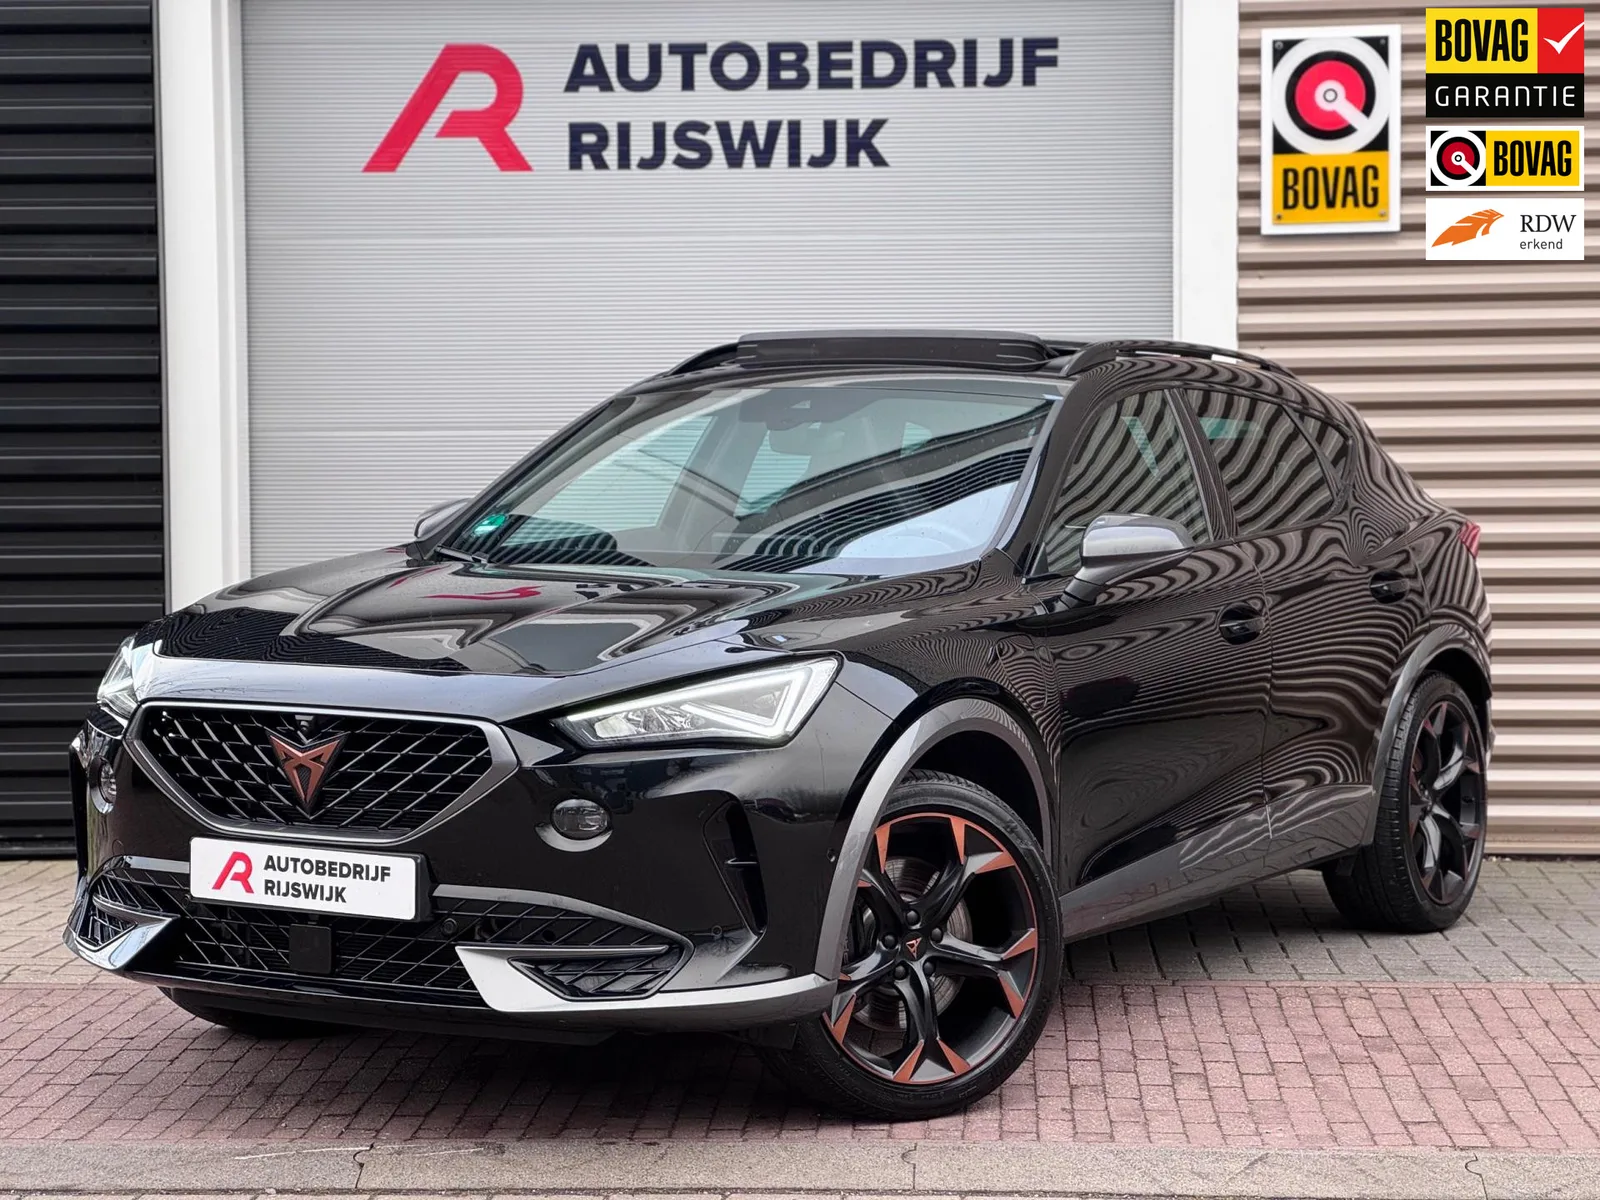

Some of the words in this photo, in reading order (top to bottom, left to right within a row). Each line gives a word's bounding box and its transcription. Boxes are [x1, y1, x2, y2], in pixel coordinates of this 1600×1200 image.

[564, 37, 1060, 93] AUTOBEDRIJF
[568, 119, 891, 171] RIJSWIJK
[1282, 164, 1379, 210] BOVAG
[263, 855, 391, 882] AUTOBEDRIJF
[264, 880, 347, 903] RIJSWIJK
